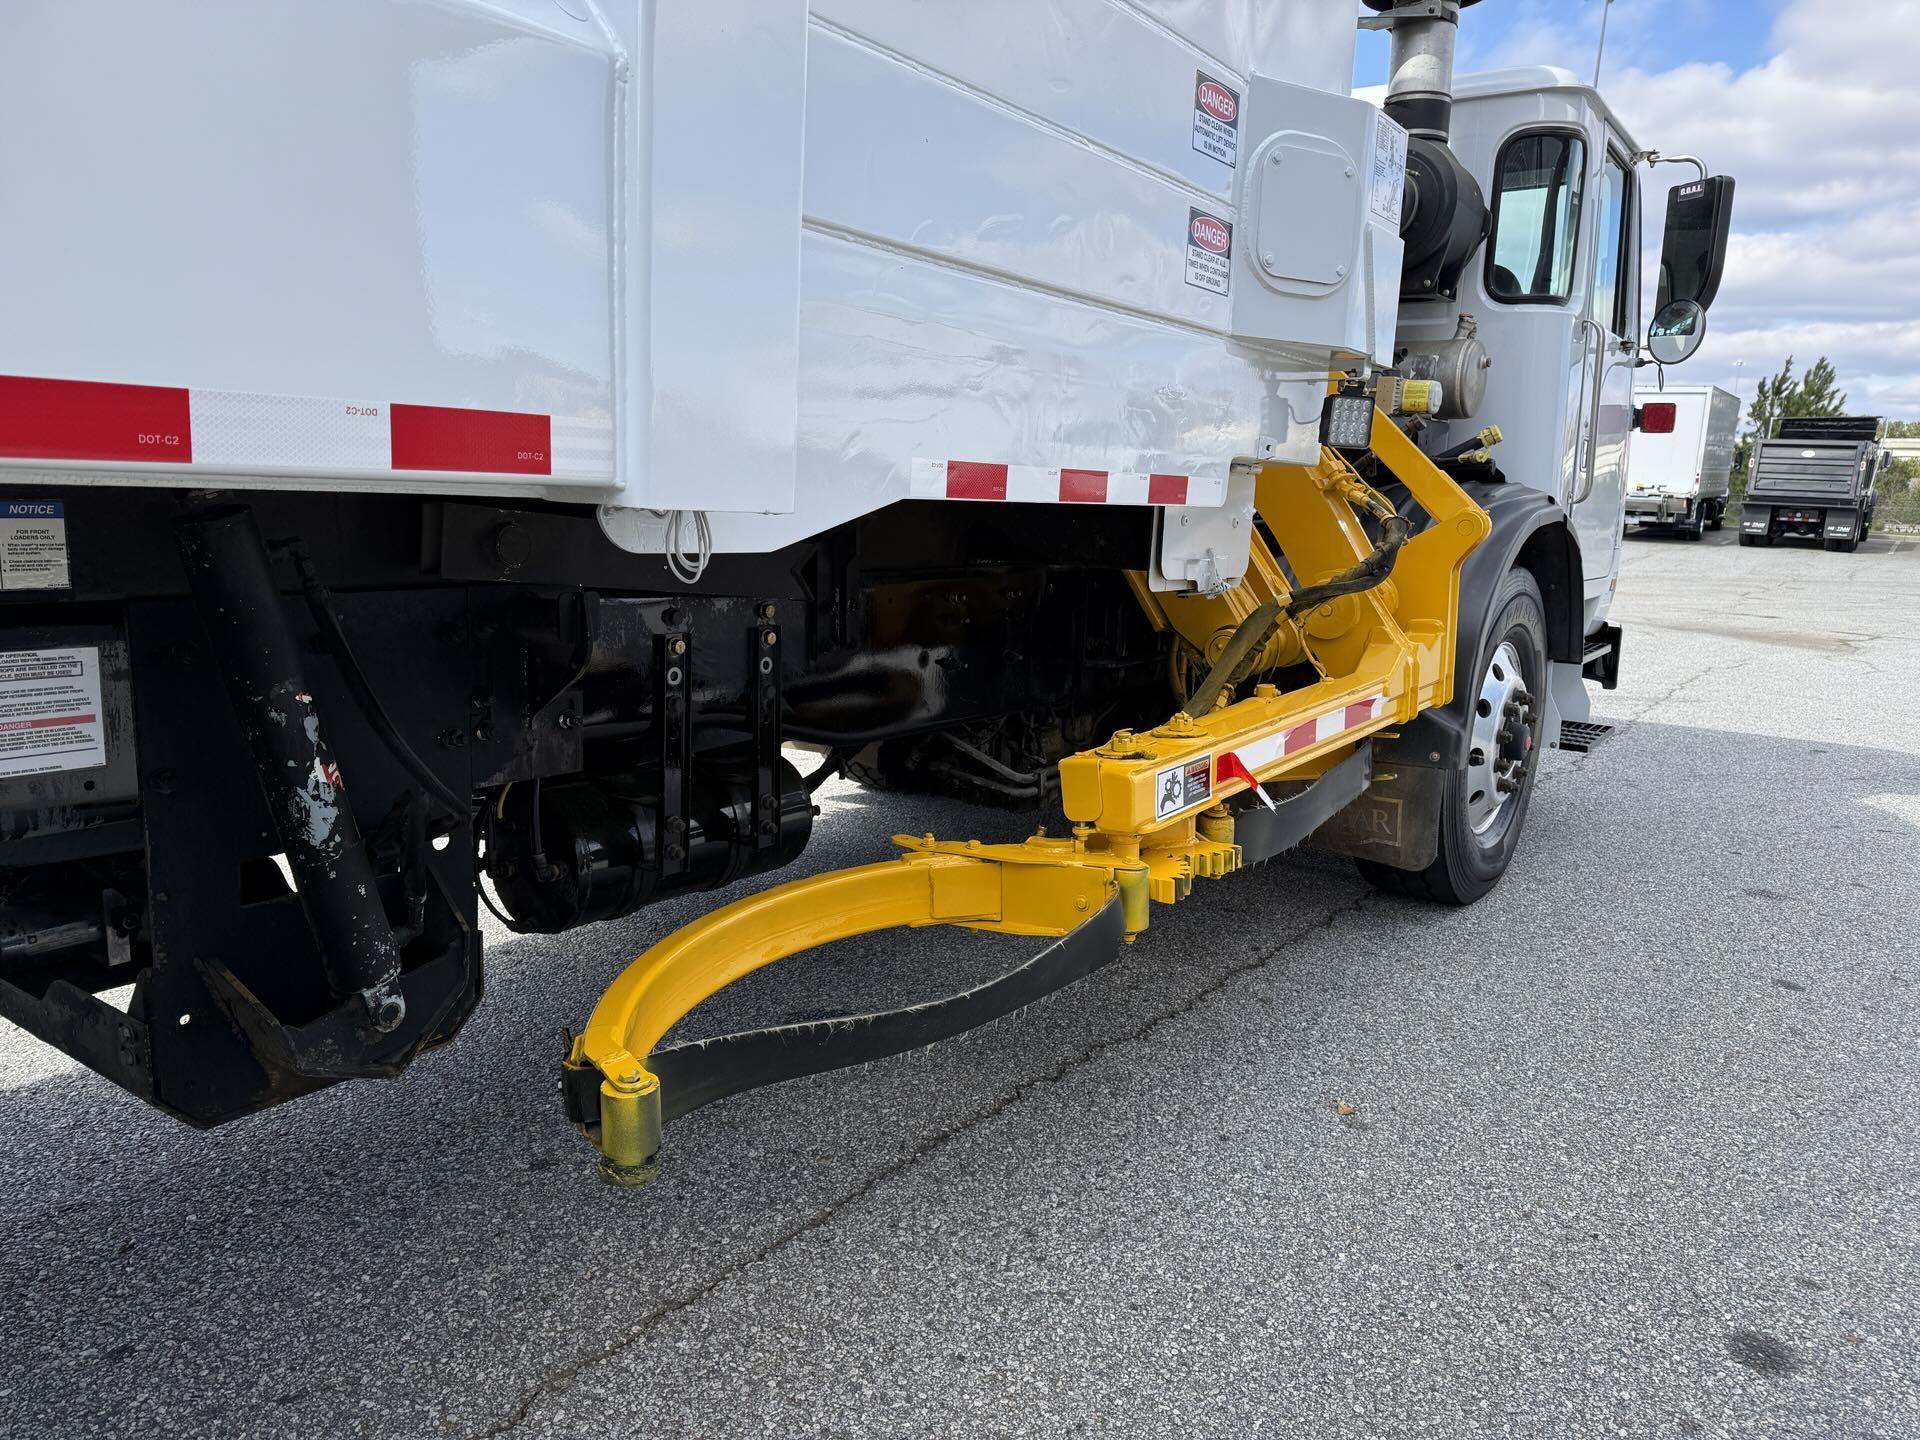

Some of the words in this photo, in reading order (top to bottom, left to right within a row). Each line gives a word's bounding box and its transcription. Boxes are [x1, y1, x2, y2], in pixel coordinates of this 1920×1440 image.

[1201, 86, 1234, 118] DANGER
[1194, 221, 1227, 248] DANGER
[345, 406, 378, 416] DOT-C2
[138, 434, 180, 445] DOT-C2
[517, 452, 544, 461] DOT-C2
[9, 504, 55, 514] NOTICE
[0, 722, 32, 731] DANGER
